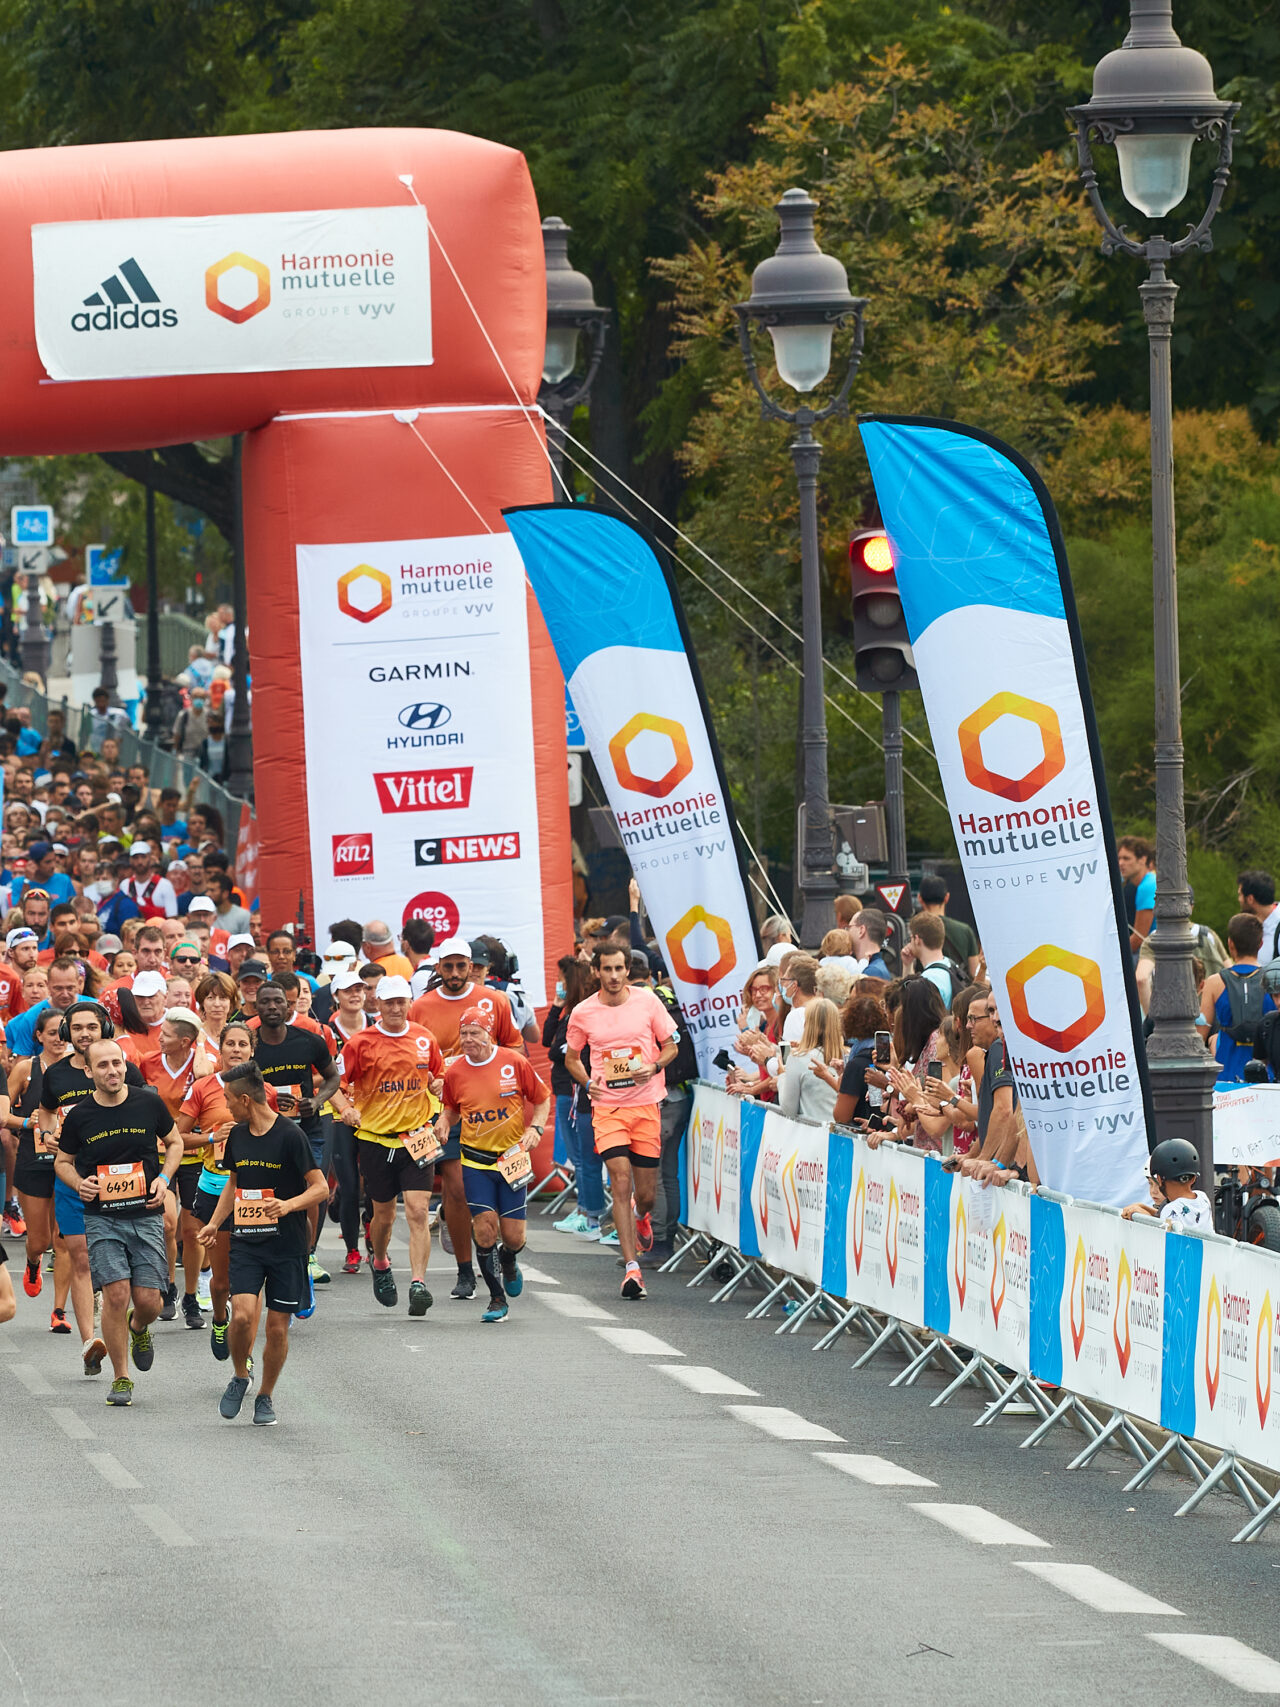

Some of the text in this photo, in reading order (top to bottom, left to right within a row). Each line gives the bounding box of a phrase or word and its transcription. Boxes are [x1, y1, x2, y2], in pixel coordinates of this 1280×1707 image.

[281, 249, 394, 271] Harmonie
[281, 268, 395, 290] mutuelle
[71, 304, 178, 331] adidas
[283, 303, 395, 319] GROUPE vyv
[400, 559, 493, 579] Harmonie
[401, 575, 493, 595] mutuelle
[387, 733, 464, 749] HYUNDAI
[383, 773, 463, 807] Vittel
[616, 793, 717, 828] Harmonie
[958, 798, 1091, 834] Harmonie
[623, 810, 721, 845] mutuelle
[964, 820, 1094, 856] mutuelle
[336, 844, 371, 863] RTL2
[446, 836, 517, 860] NEWS
[972, 859, 1098, 890] GROUPE vyv
[413, 906, 446, 919] neo
[1012, 1048, 1126, 1079] Harmonie
[1019, 1072, 1129, 1101] mutuelle
[467, 1107, 510, 1124] JACK
[1094, 1111, 1134, 1134] vyv
[107, 1180, 134, 1193] 6491
[238, 1207, 265, 1218] 1235
[1222, 1284, 1251, 1326] Harmonie
[1222, 1325, 1248, 1363] mutuelle
